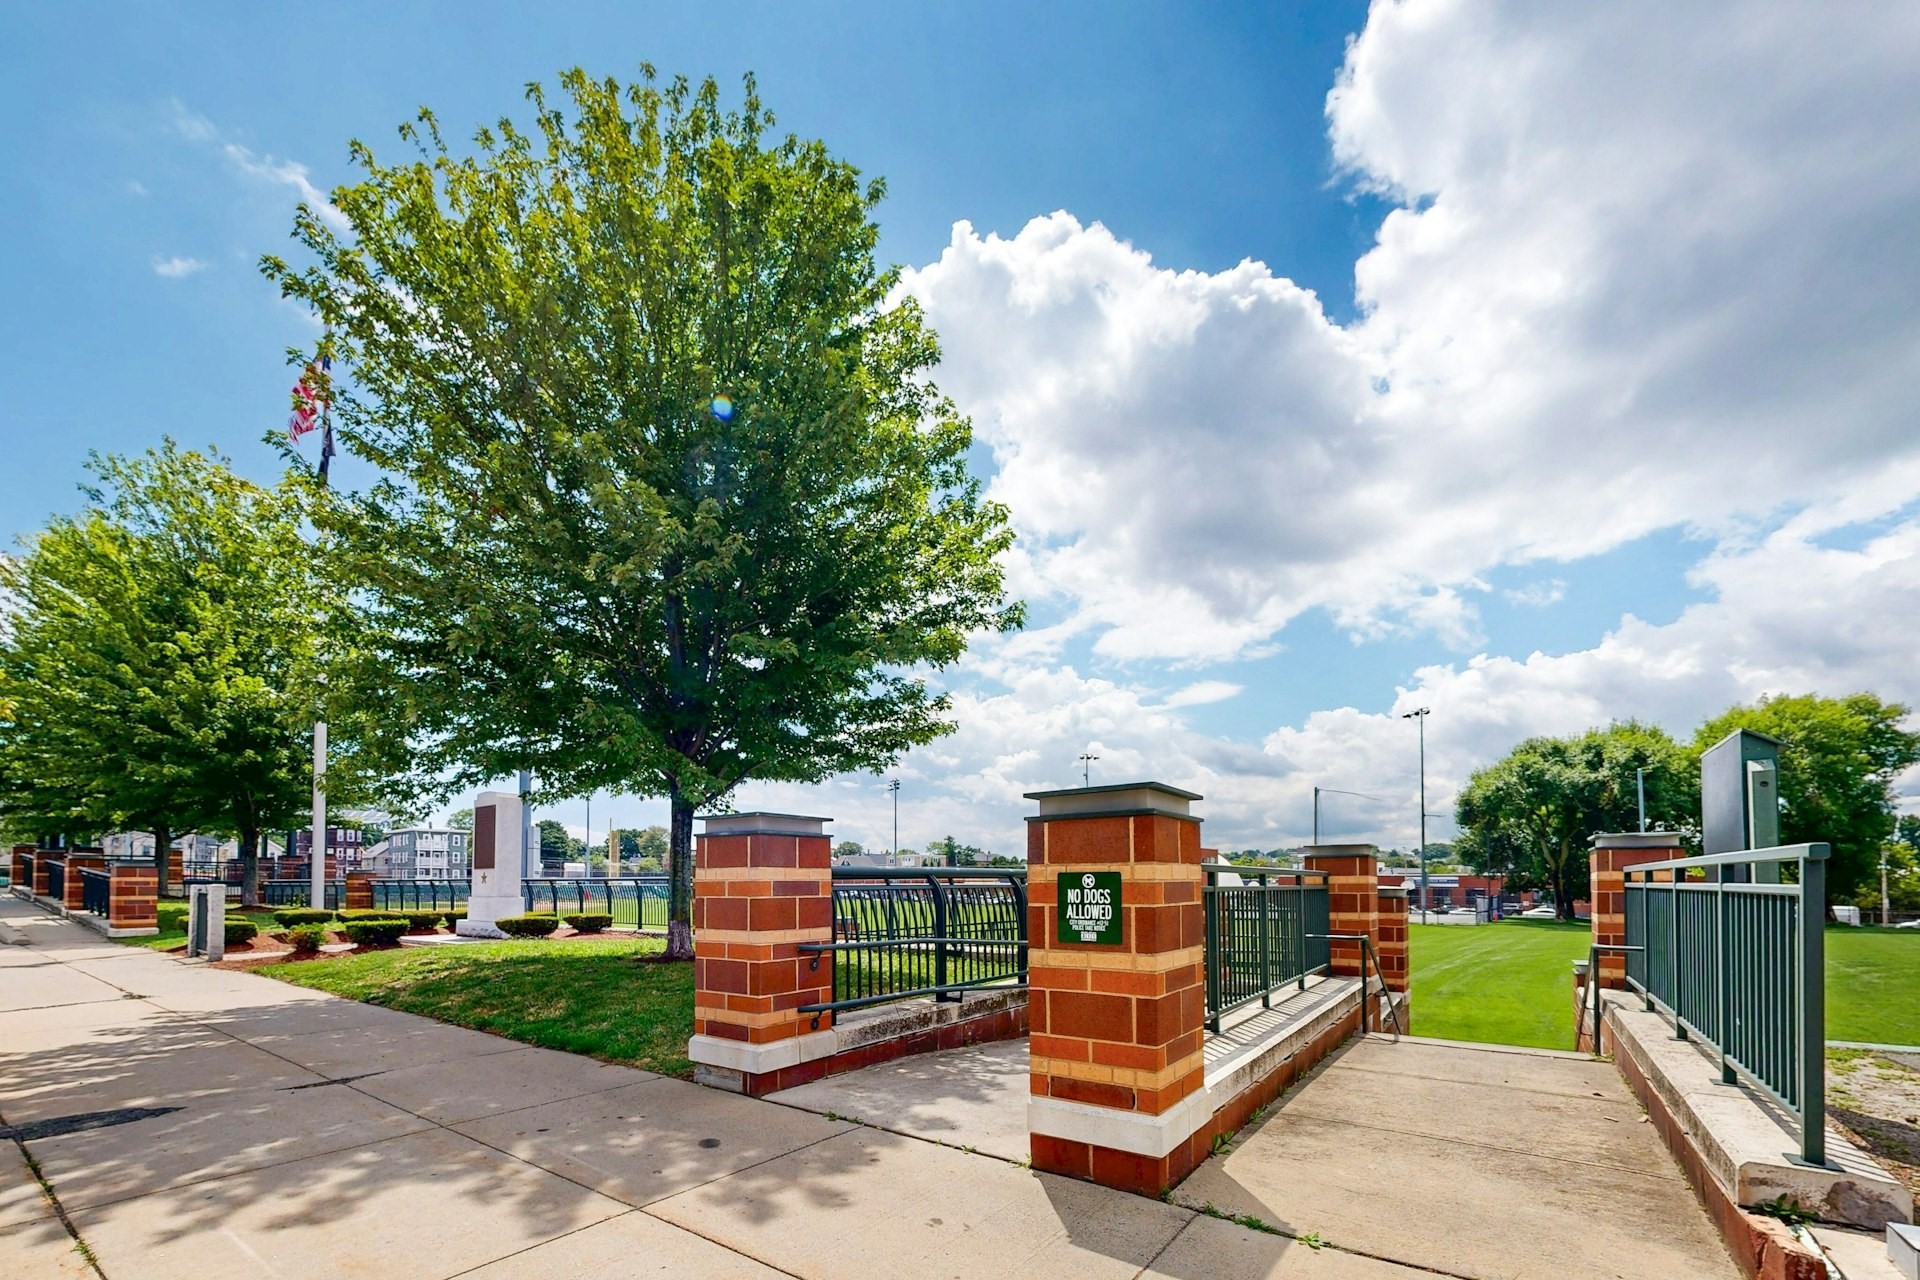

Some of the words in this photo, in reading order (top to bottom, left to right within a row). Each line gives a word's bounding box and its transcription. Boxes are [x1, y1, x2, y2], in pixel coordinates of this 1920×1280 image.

[1067, 888, 1081, 904] NO
[1084, 888, 1111, 904] DOGS
[1066, 904, 1113, 920] ALLOWED
